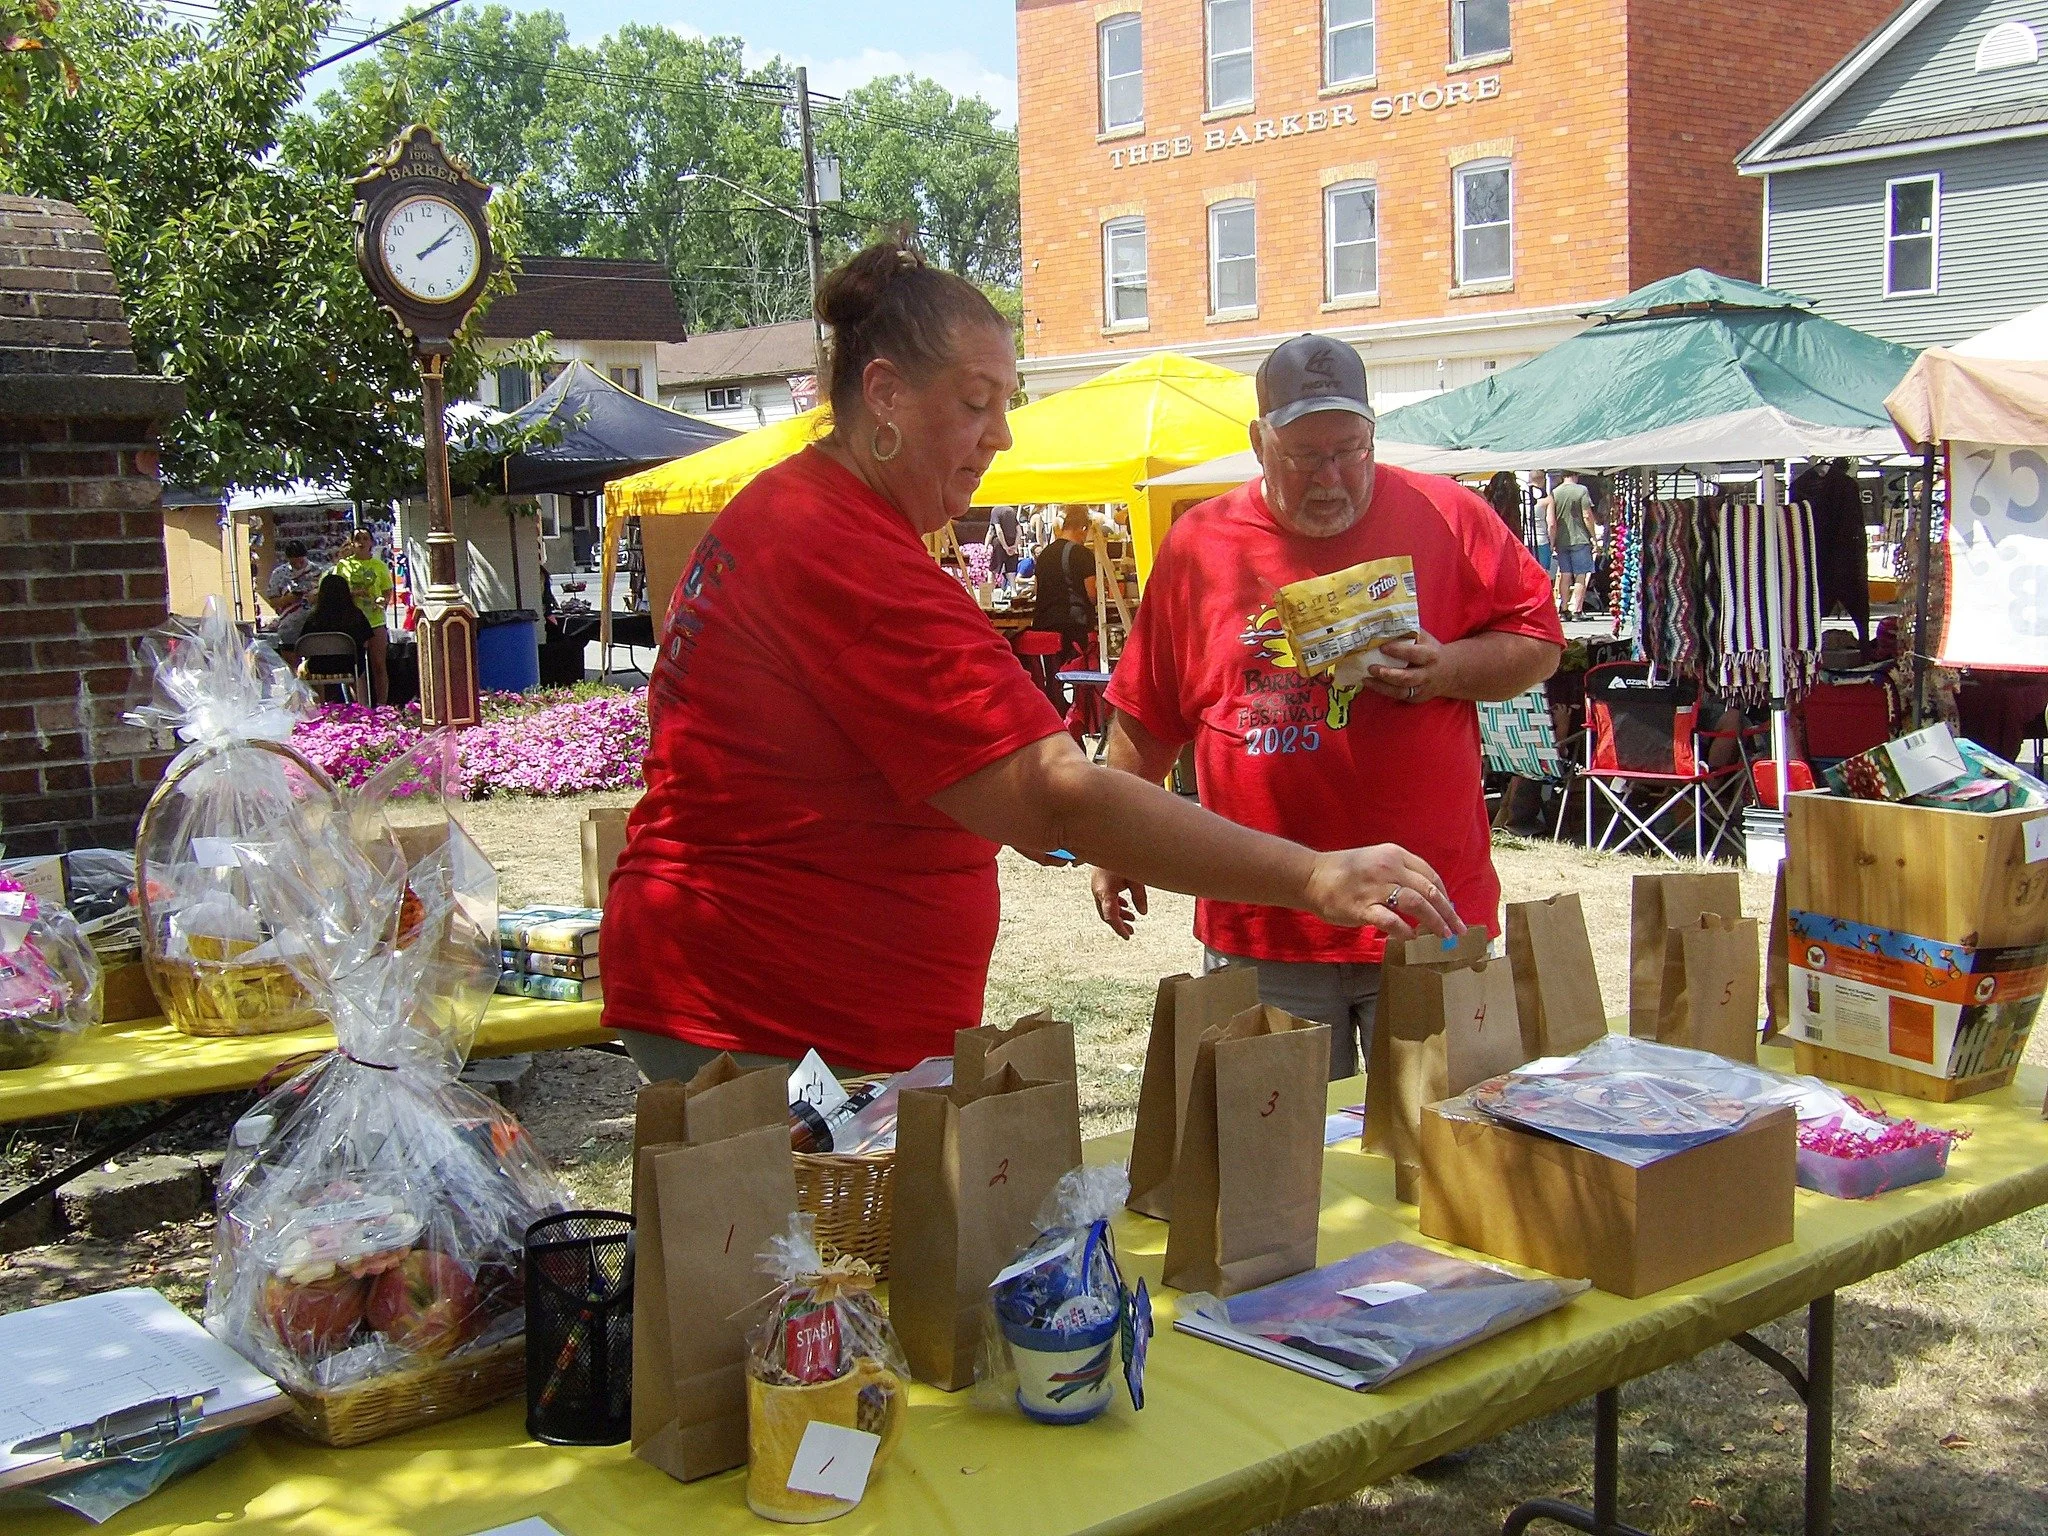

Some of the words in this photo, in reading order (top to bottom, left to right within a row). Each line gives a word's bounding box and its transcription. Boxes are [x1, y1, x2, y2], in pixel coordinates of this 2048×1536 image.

[1109, 135, 1192, 169] THEE
[1204, 103, 1358, 151] BARKER
[1370, 75, 1501, 120] STORE
[389, 164, 460, 185] BARKER
[404, 211, 415, 223] 11
[421, 206, 433, 218] 12
[443, 213, 448, 223] 1
[393, 225, 405, 236] 10
[388, 244, 396, 255] 9
[463, 245, 470, 256] 3
[395, 264, 403, 275] 8
[457, 264, 465, 275] 4
[410, 277, 417, 289] 7
[427, 282, 436, 293] 6
[446, 278, 452, 289] 5
[1238, 706, 1326, 729] FESTIVAL
[1244, 724, 1320, 755] 2025
[1720, 980, 1735, 1005] 5
[1473, 1004, 1487, 1032] 4
[1260, 1091, 1279, 1117] 3
[989, 1158, 1008, 1185] 2
[725, 1224, 734, 1253] 1
[796, 1319, 835, 1347] STASH
[819, 1456, 834, 1475] 1
